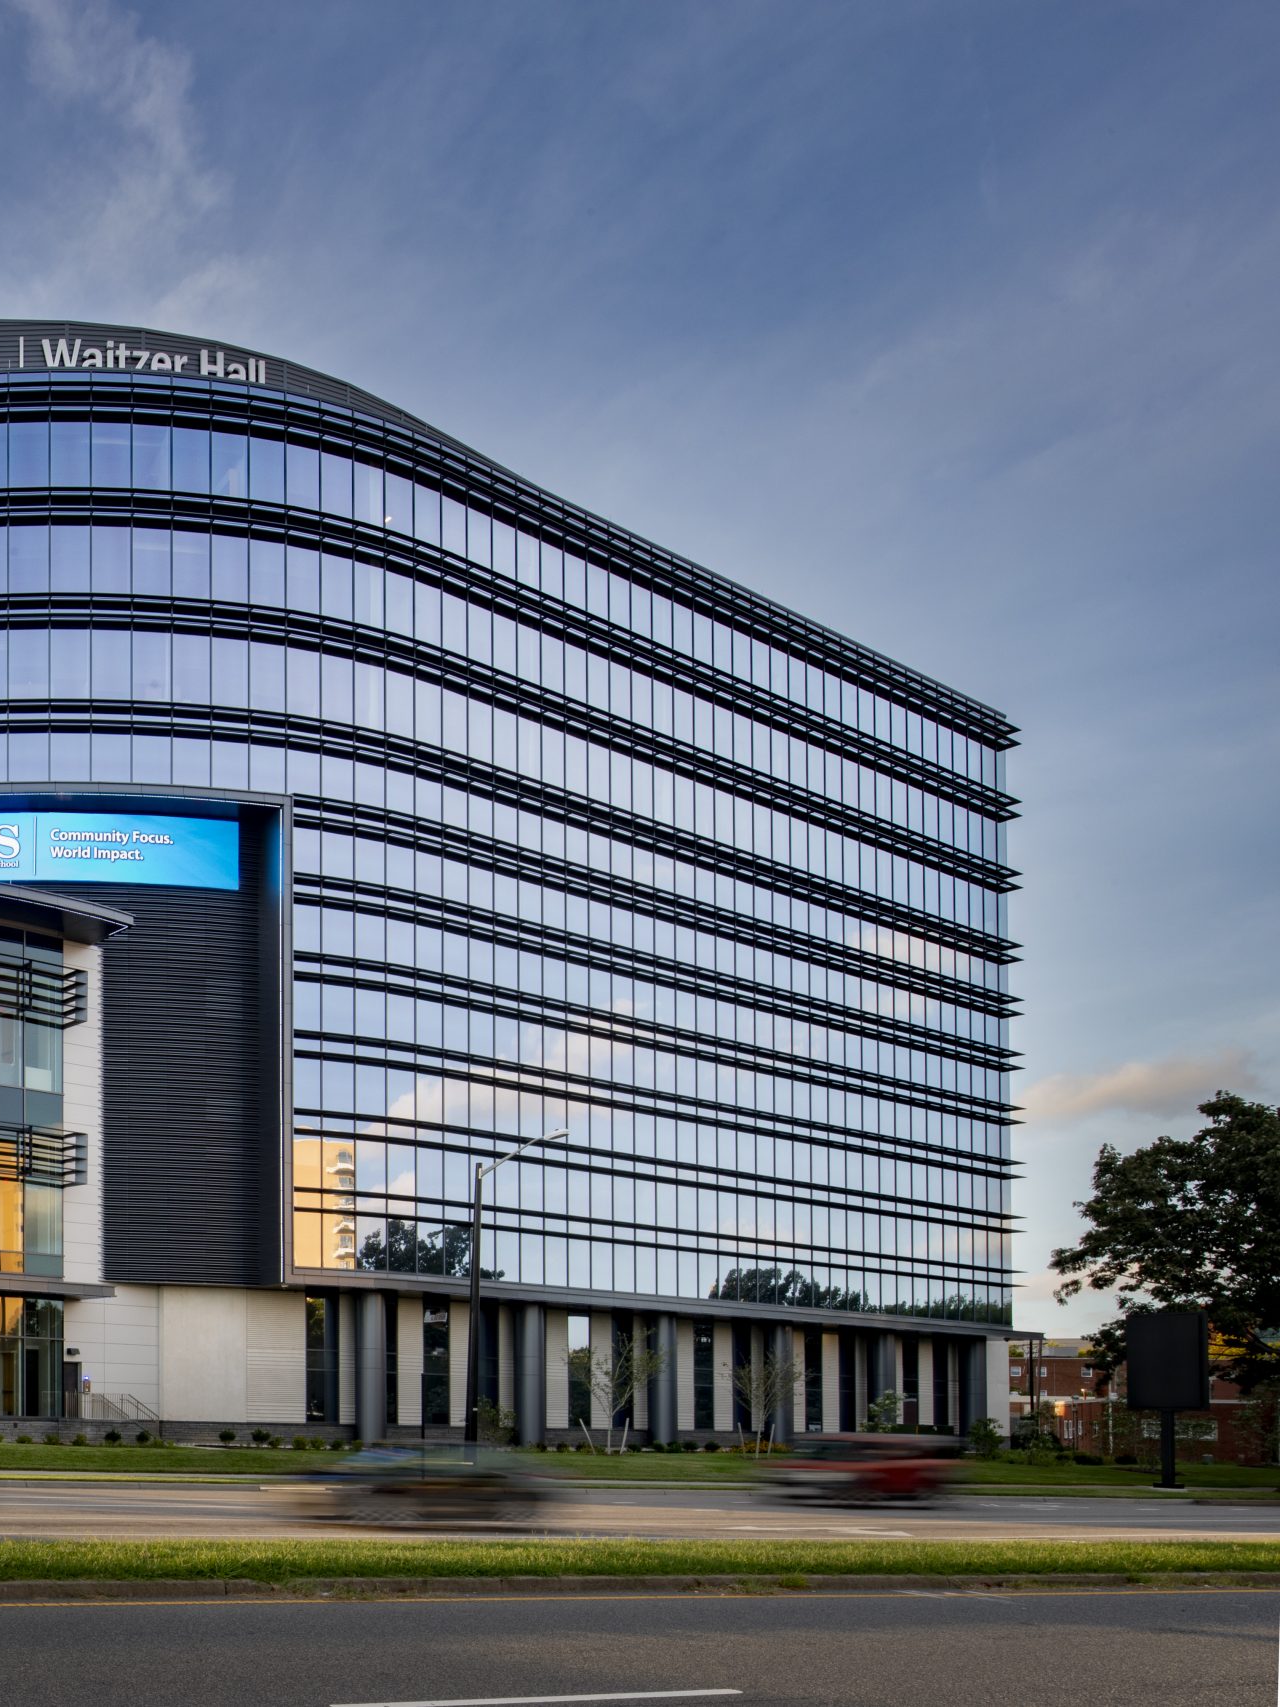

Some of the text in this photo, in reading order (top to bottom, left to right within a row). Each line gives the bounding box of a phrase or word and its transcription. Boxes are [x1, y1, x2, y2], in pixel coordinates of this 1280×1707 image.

[41, 339, 188, 373] Waitzer
[200, 349, 266, 384] Hall
[50, 829, 174, 845] Community Focus.
[50, 846, 144, 862] World Impact.
